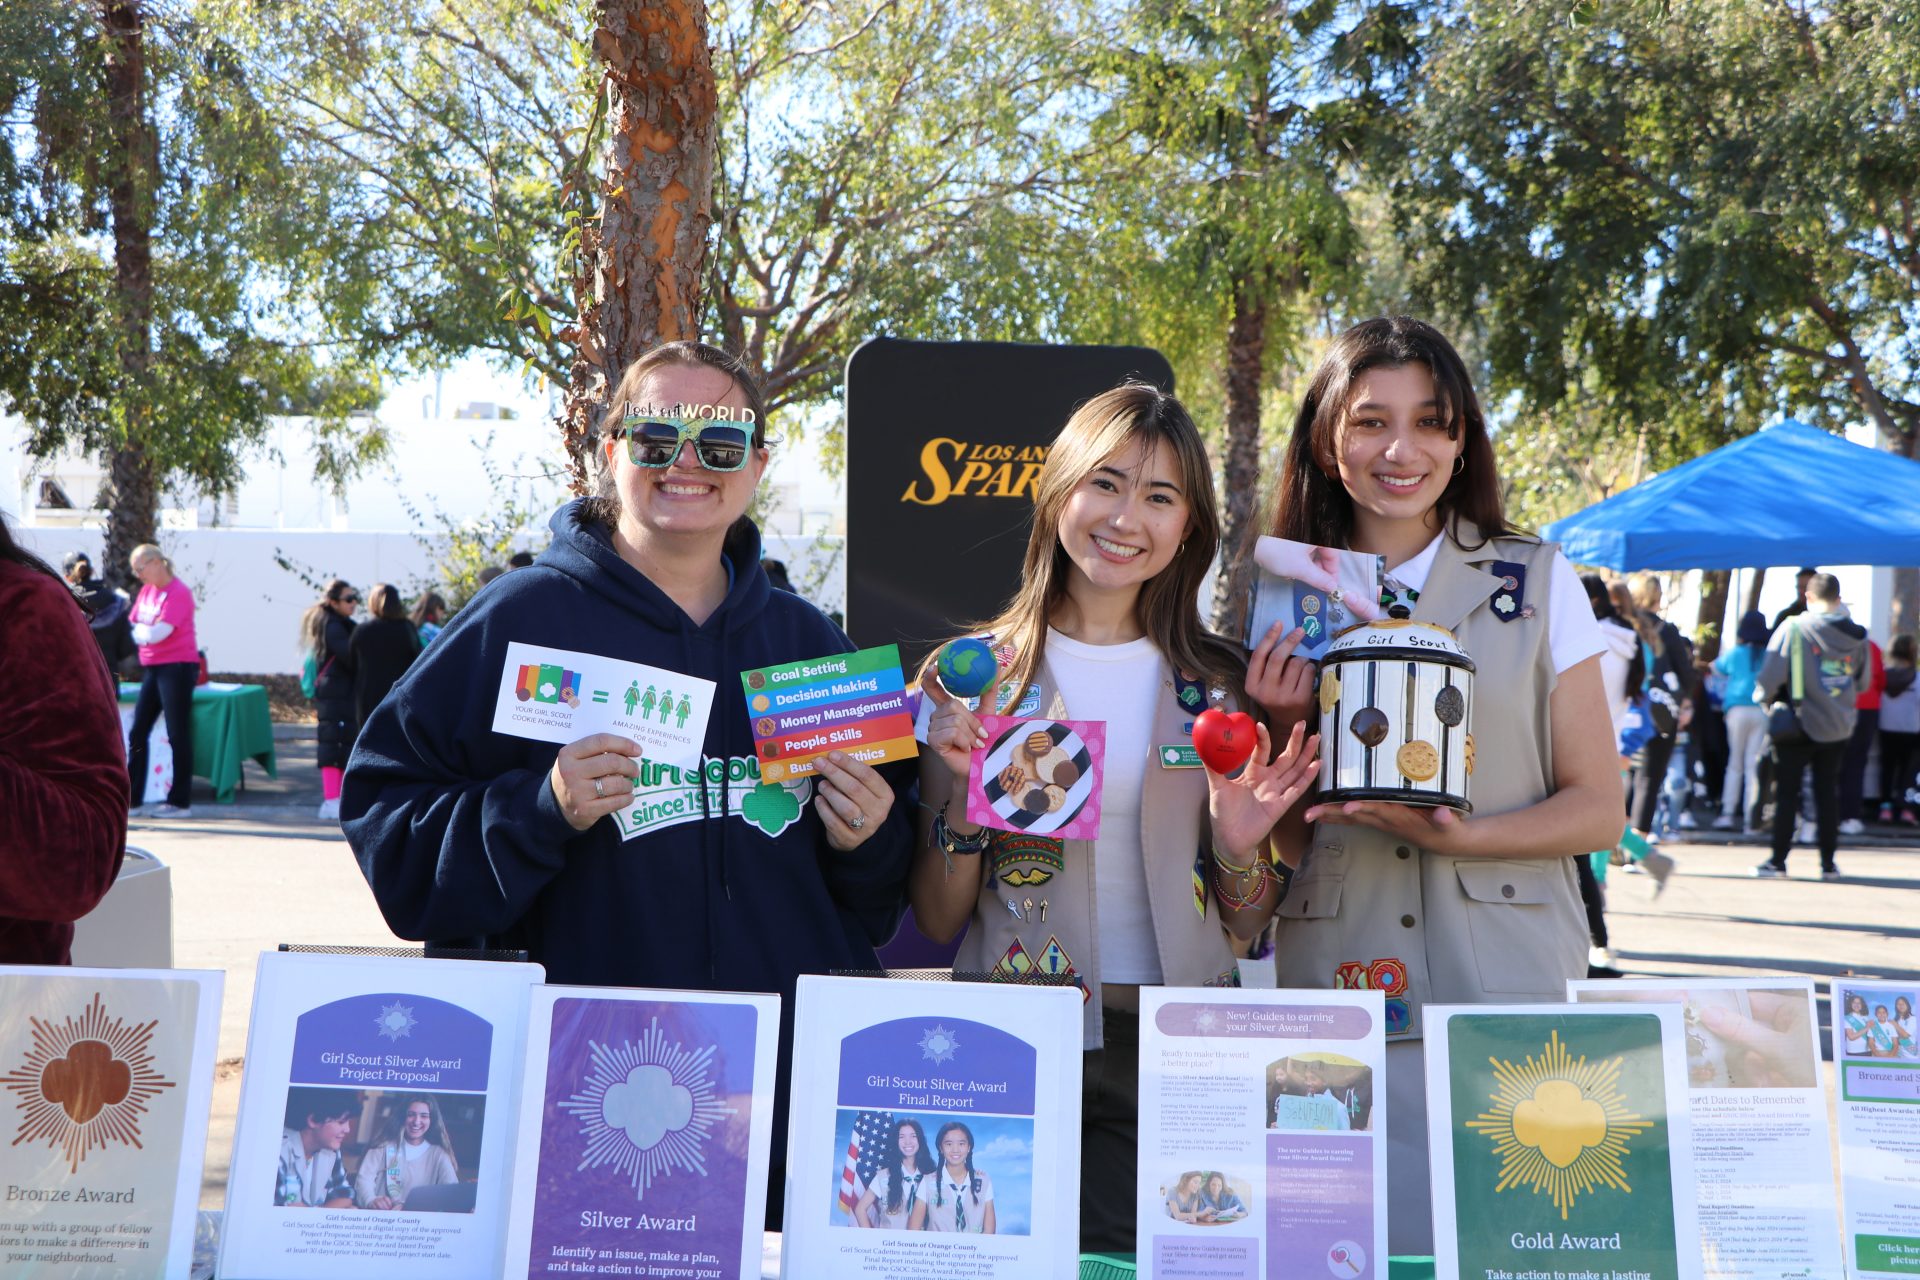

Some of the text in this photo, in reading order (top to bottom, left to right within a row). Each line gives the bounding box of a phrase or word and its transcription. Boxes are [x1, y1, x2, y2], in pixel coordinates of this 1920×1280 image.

[680, 403, 755, 424] WORLD
[968, 444, 1015, 460] LOS
[901, 437, 1045, 506] SPAR
[1367, 634, 1394, 645] Girl
[1409, 635, 1448, 650] Scout
[771, 660, 848, 683] Goal Setting
[776, 678, 878, 706] Decision Making
[514, 705, 572, 720] YOUR GIRL SCOUT
[780, 696, 903, 729] Money Management
[511, 713, 572, 729] COOKIE PURCHASE
[612, 720, 691, 745] AMAZING EXPERIENCES
[633, 733, 668, 748] FOR GIRLS
[784, 728, 863, 752] People Skills
[848, 748, 885, 763] thics
[632, 757, 682, 787] irl
[684, 757, 761, 784] cou
[632, 796, 685, 826] since
[1226, 1010, 1335, 1024] New! Guides to earning
[1226, 1022, 1312, 1033] your Silver Award.
[321, 1052, 462, 1070] Girl Scout Silver Award
[1161, 1050, 1183, 1059] Ready
[339, 1067, 440, 1084] Project Proposal
[1858, 1071, 1893, 1082] Bronze
[1895, 1072, 1913, 1083] and
[867, 1075, 1007, 1094] Girl Scout Silver Award
[899, 1093, 974, 1109] Final Report
[1689, 1096, 1806, 1105] ard Dates to Remember
[6, 1185, 135, 1204] Bronze Award
[325, 1214, 339, 1222] Girl
[341, 1215, 362, 1223] Scouts
[371, 1216, 395, 1225] Orange
[397, 1217, 421, 1225] County
[580, 1210, 696, 1232] Silver Award
[14, 1223, 30, 1234] up
[32, 1221, 58, 1233] with
[69, 1224, 102, 1235] group
[104, 1223, 117, 1234] of
[119, 1224, 153, 1235] fellow
[0, 1235, 149, 1249] iors to make a difference in
[897, 1240, 919, 1249] Scouts
[928, 1242, 952, 1251] Orange
[953, 1243, 977, 1252] County
[1511, 1232, 1622, 1250] Gold Award
[1878, 1243, 1920, 1254] Click her
[6, 1251, 117, 1264] your neighborhood.
[552, 1245, 720, 1265] Identify an issue, make a plan,
[1890, 1256, 1920, 1265] pictur
[547, 1260, 722, 1280] and take action to improve your
[1485, 1269, 1513, 1280] Take
[1516, 1269, 1551, 1280] action
[1554, 1270, 1565, 1280] to
[1568, 1270, 1600, 1280] make
[1612, 1270, 1651, 1280] lasting
